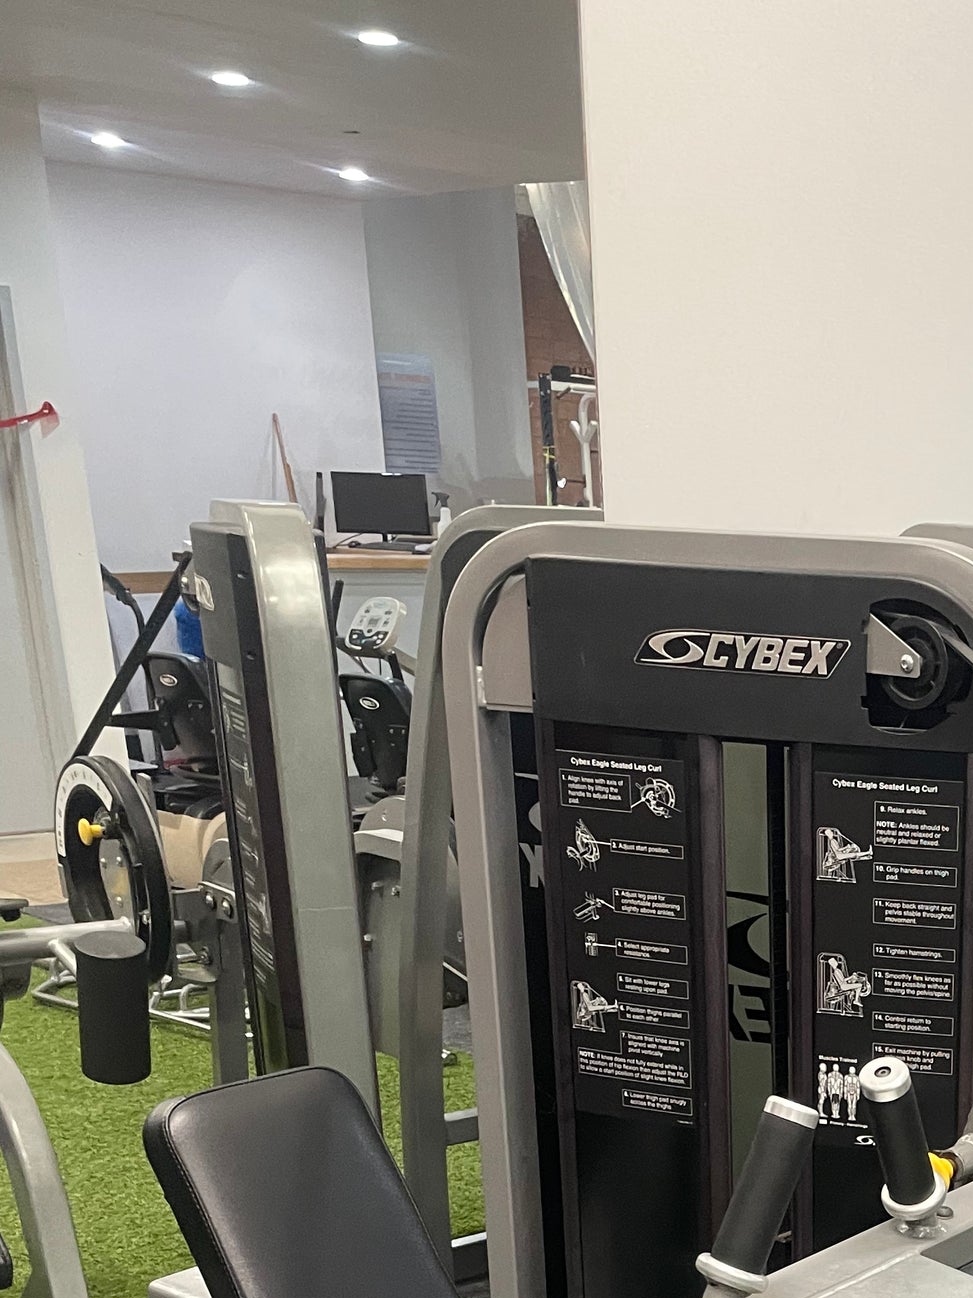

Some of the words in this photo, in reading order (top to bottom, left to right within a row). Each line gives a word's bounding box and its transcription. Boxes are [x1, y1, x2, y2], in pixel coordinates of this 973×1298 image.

[703, 633, 837, 675] CYBEX
[571, 757, 590, 766] Cybex
[592, 759, 609, 768] Eagle
[611, 761, 633, 769] Seated
[634, 763, 646, 772] Leg
[832, 779, 855, 788] Cybex
[857, 781, 877, 790] Eagle
[906, 785, 920, 793] Leg
[906, 807, 927, 815] ankles.
[899, 822, 919, 830] Ankles
[886, 866, 899, 874] Grip
[900, 866, 923, 874] handles
[934, 869, 949, 877] thigh
[886, 947, 908, 955] Tighten
[909, 949, 942, 959] hamstrings.
[902, 981, 926, 989] possible
[885, 1015, 906, 1023] Control
[907, 1024, 931, 1032] position.
[897, 1048, 921, 1056] machine
[931, 1051, 950, 1059] pulling
